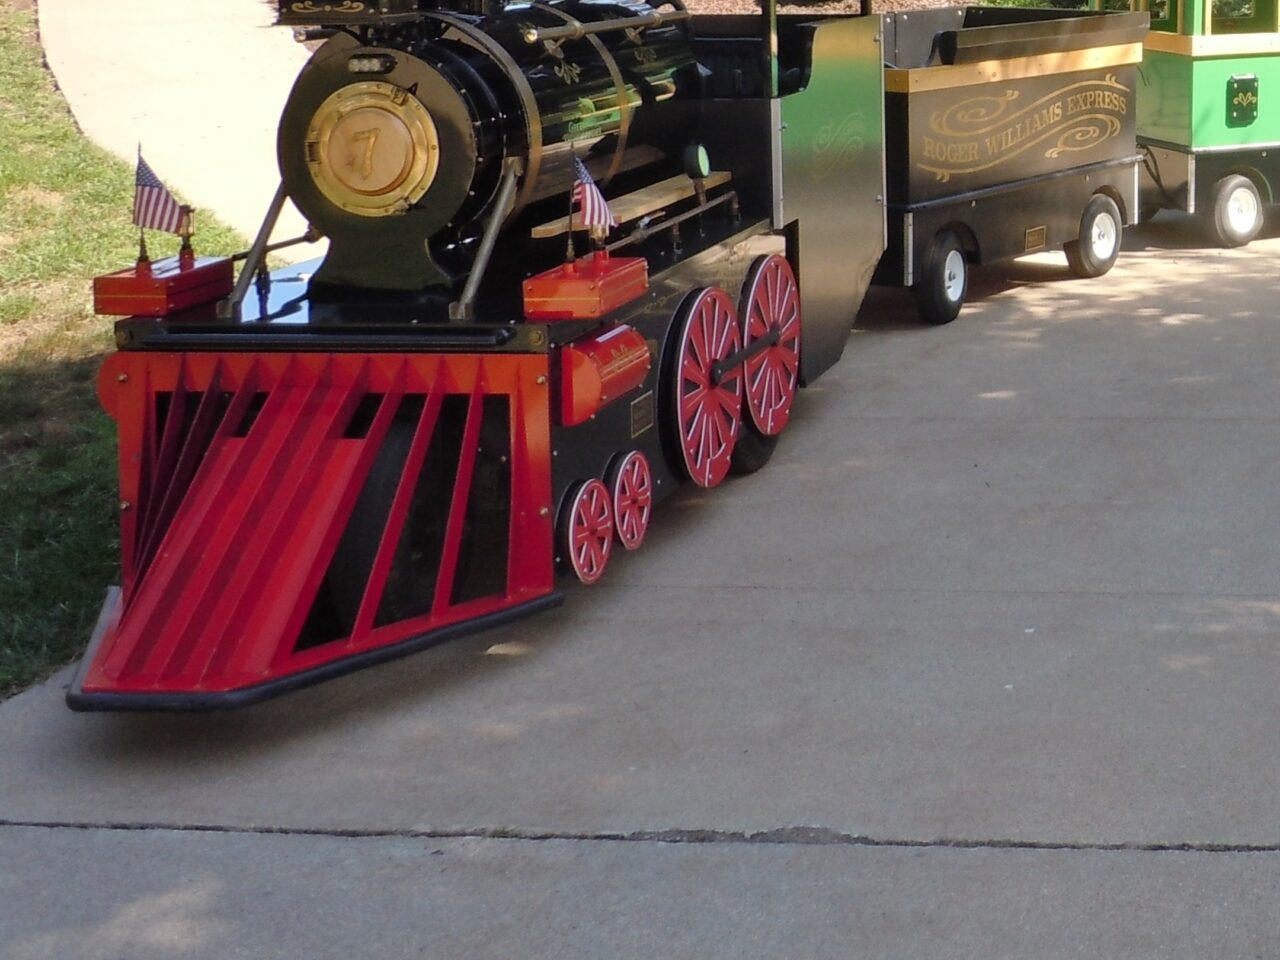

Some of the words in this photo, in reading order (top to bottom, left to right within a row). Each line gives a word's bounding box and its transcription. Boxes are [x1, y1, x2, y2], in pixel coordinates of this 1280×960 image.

[352, 127, 381, 181] 7
[923, 136, 979, 162] ROGER
[985, 102, 1063, 156] WILLIAMS
[1067, 90, 1127, 115] EXPRESS
